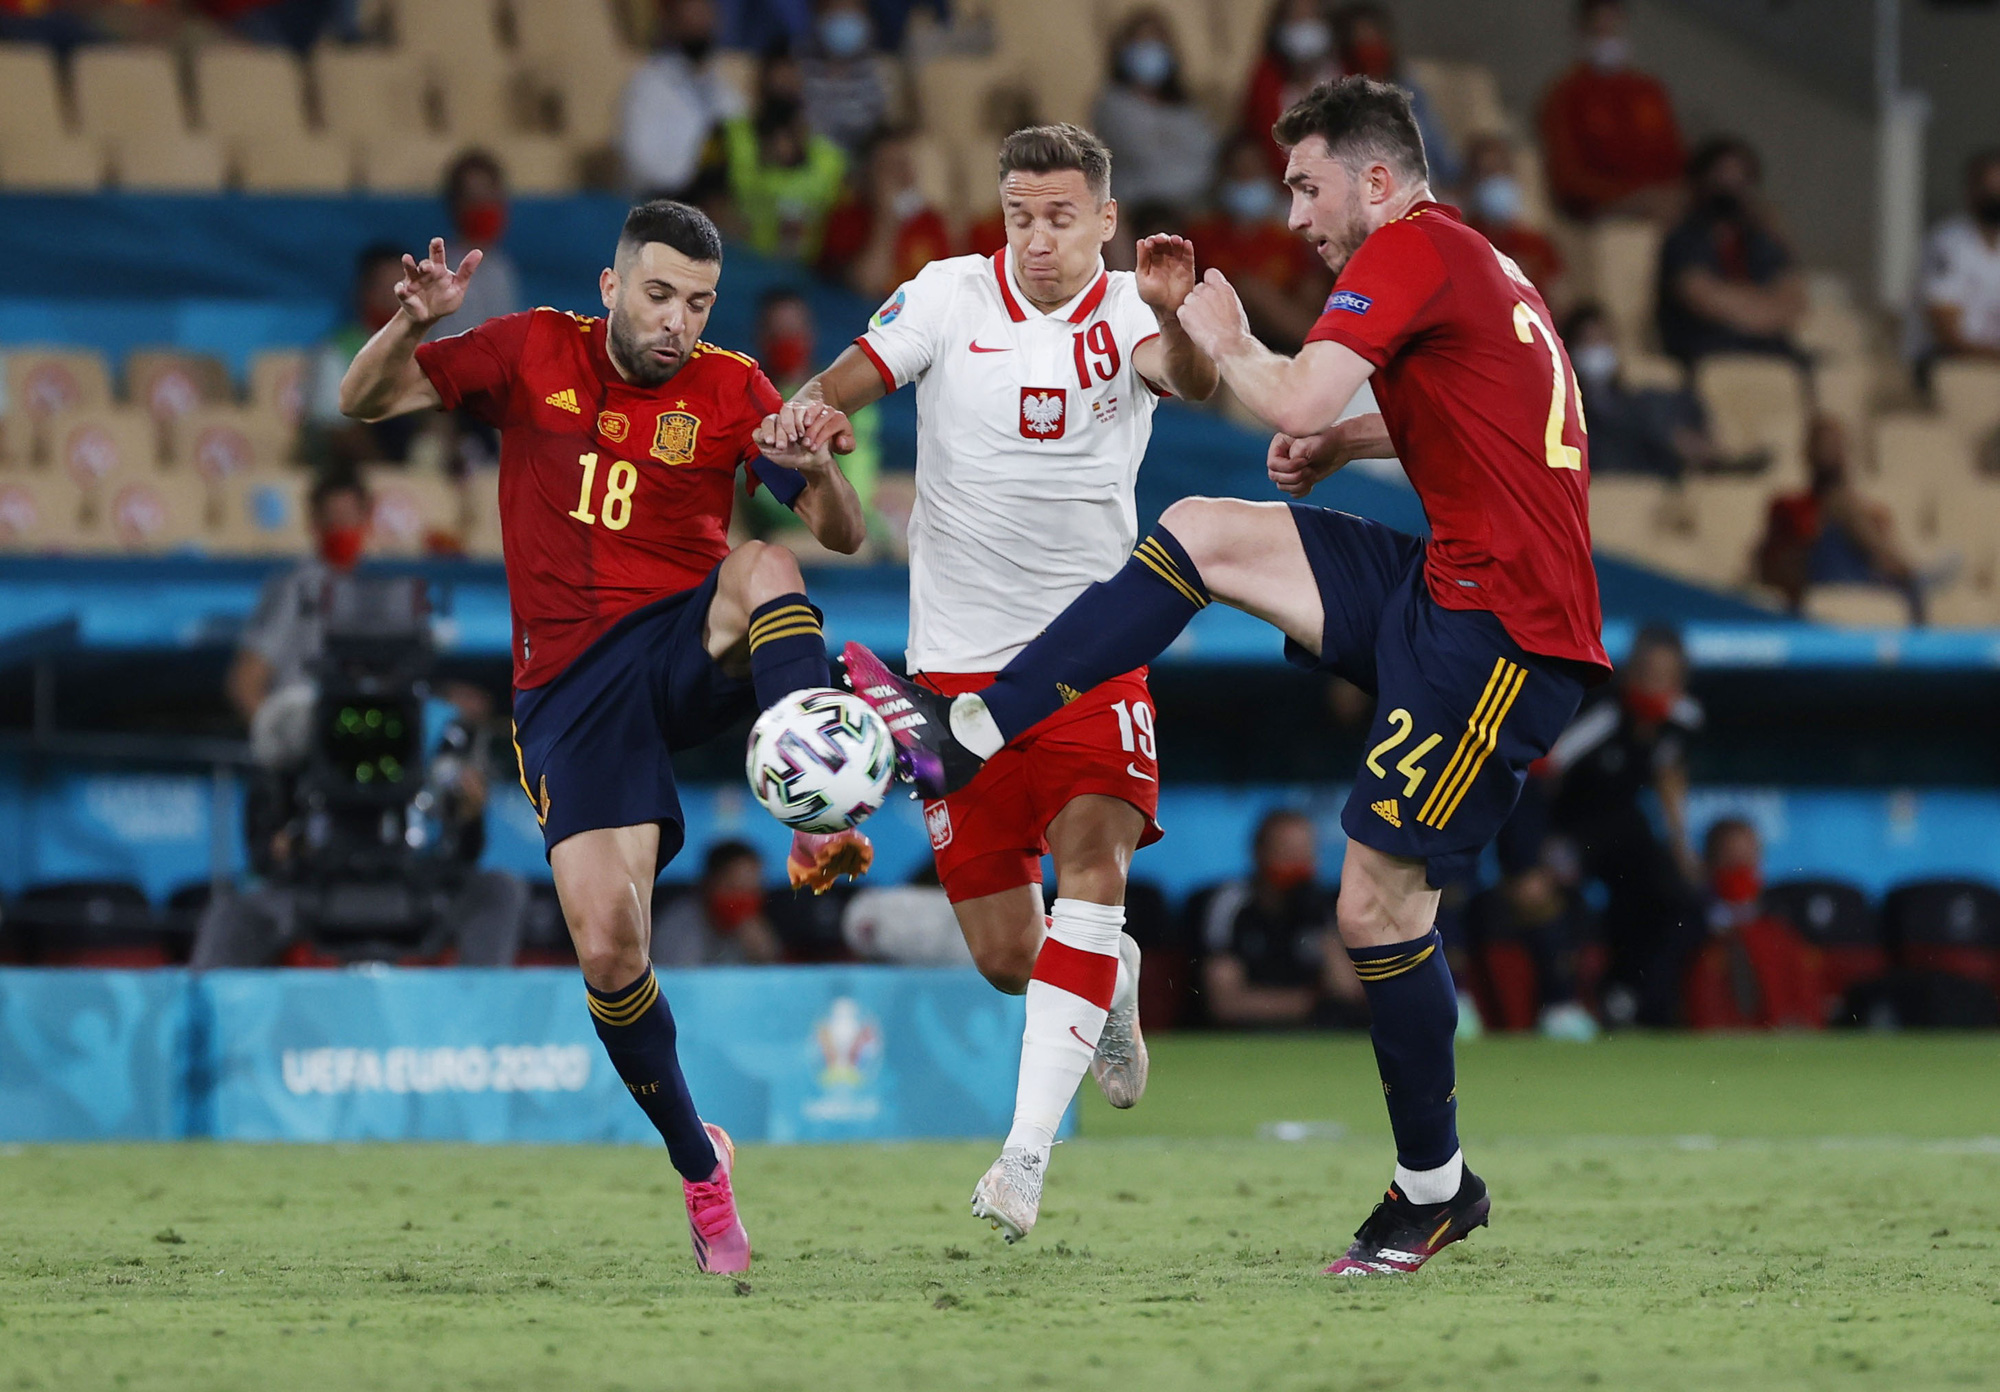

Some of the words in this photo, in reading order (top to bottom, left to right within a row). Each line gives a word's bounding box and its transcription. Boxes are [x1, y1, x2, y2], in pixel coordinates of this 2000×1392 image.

[1072, 320, 1121, 390] 19
[545, 396, 581, 415] adidas
[1512, 300, 1588, 472] 2
[568, 452, 638, 531] 18
[1110, 699, 1157, 760] 19
[1366, 708, 1444, 798] 24
[1370, 803, 1402, 828] adidas
[283, 1046, 382, 1095] UEFA
[386, 1045, 489, 1093] EURO
[492, 1044, 590, 1092] 2020
[626, 1080, 659, 1095] FEF
